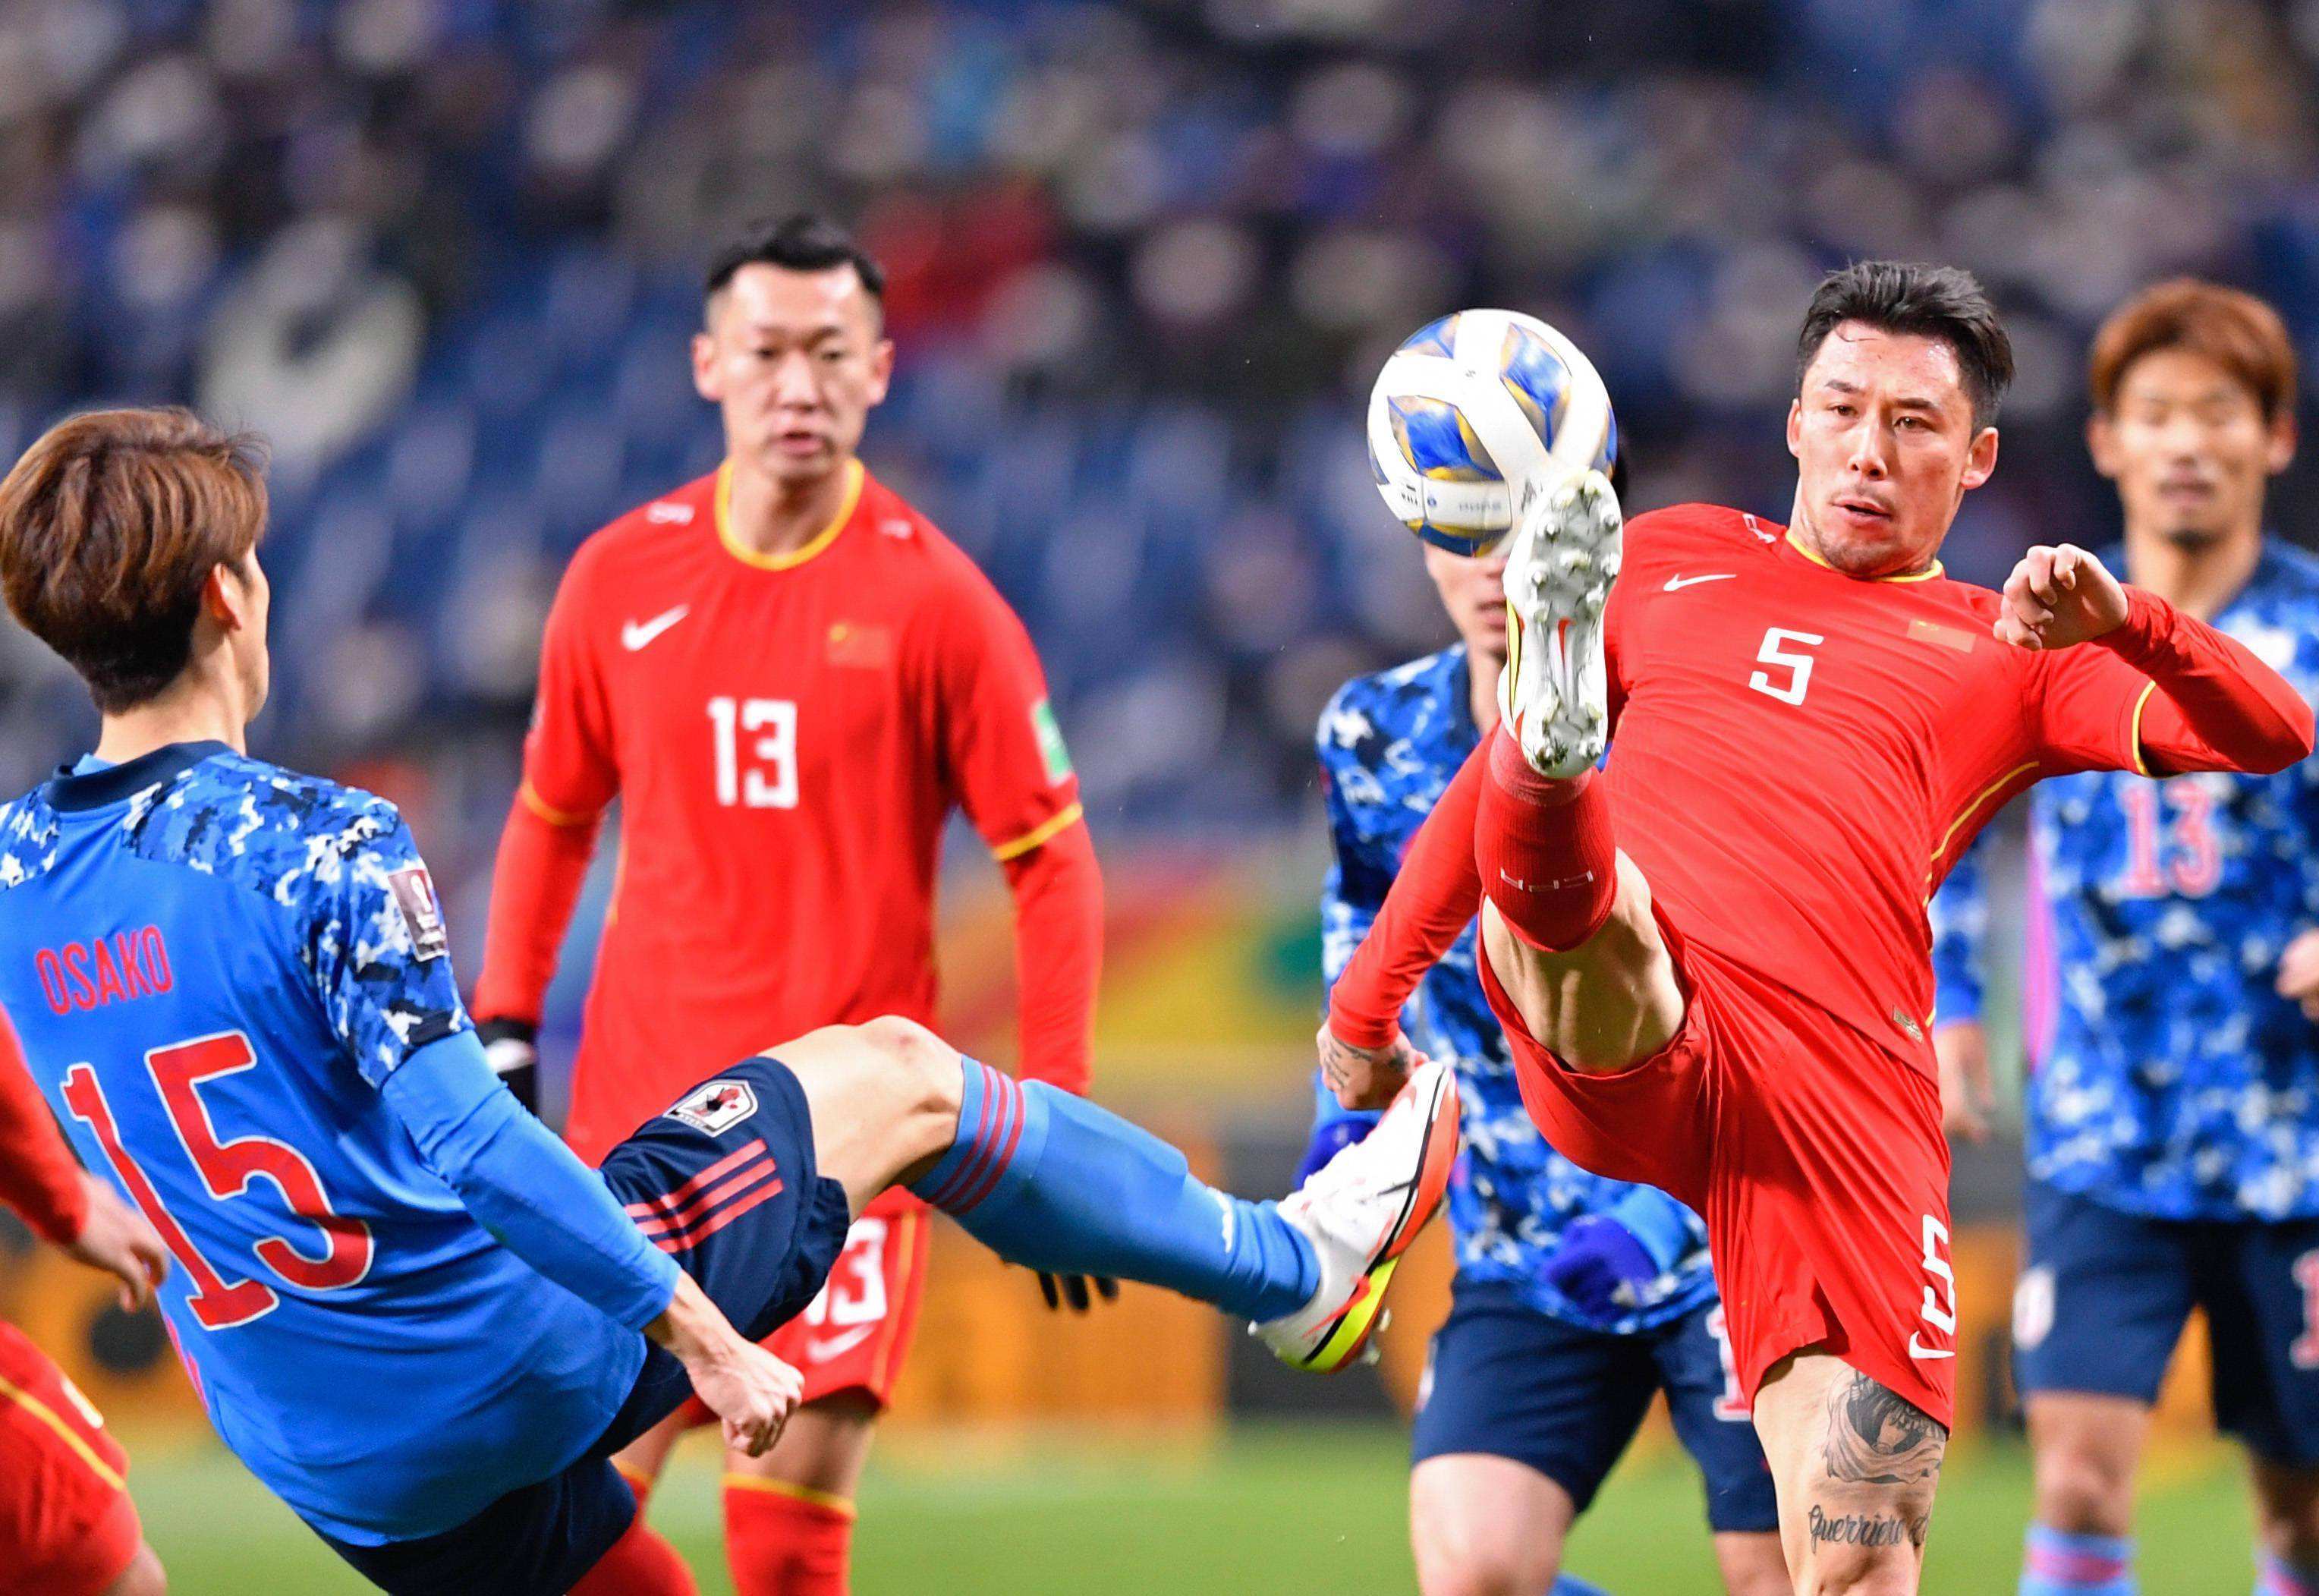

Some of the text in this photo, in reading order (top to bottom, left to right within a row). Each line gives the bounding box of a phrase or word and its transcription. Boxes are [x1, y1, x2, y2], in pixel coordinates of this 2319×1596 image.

[1749, 627, 1824, 706] 5
[706, 695, 800, 810] 13
[2122, 780, 2220, 898] 13
[35, 924, 174, 1015] OSAKO
[59, 1029, 375, 1331] 15
[1921, 1214, 1956, 1336] 5
